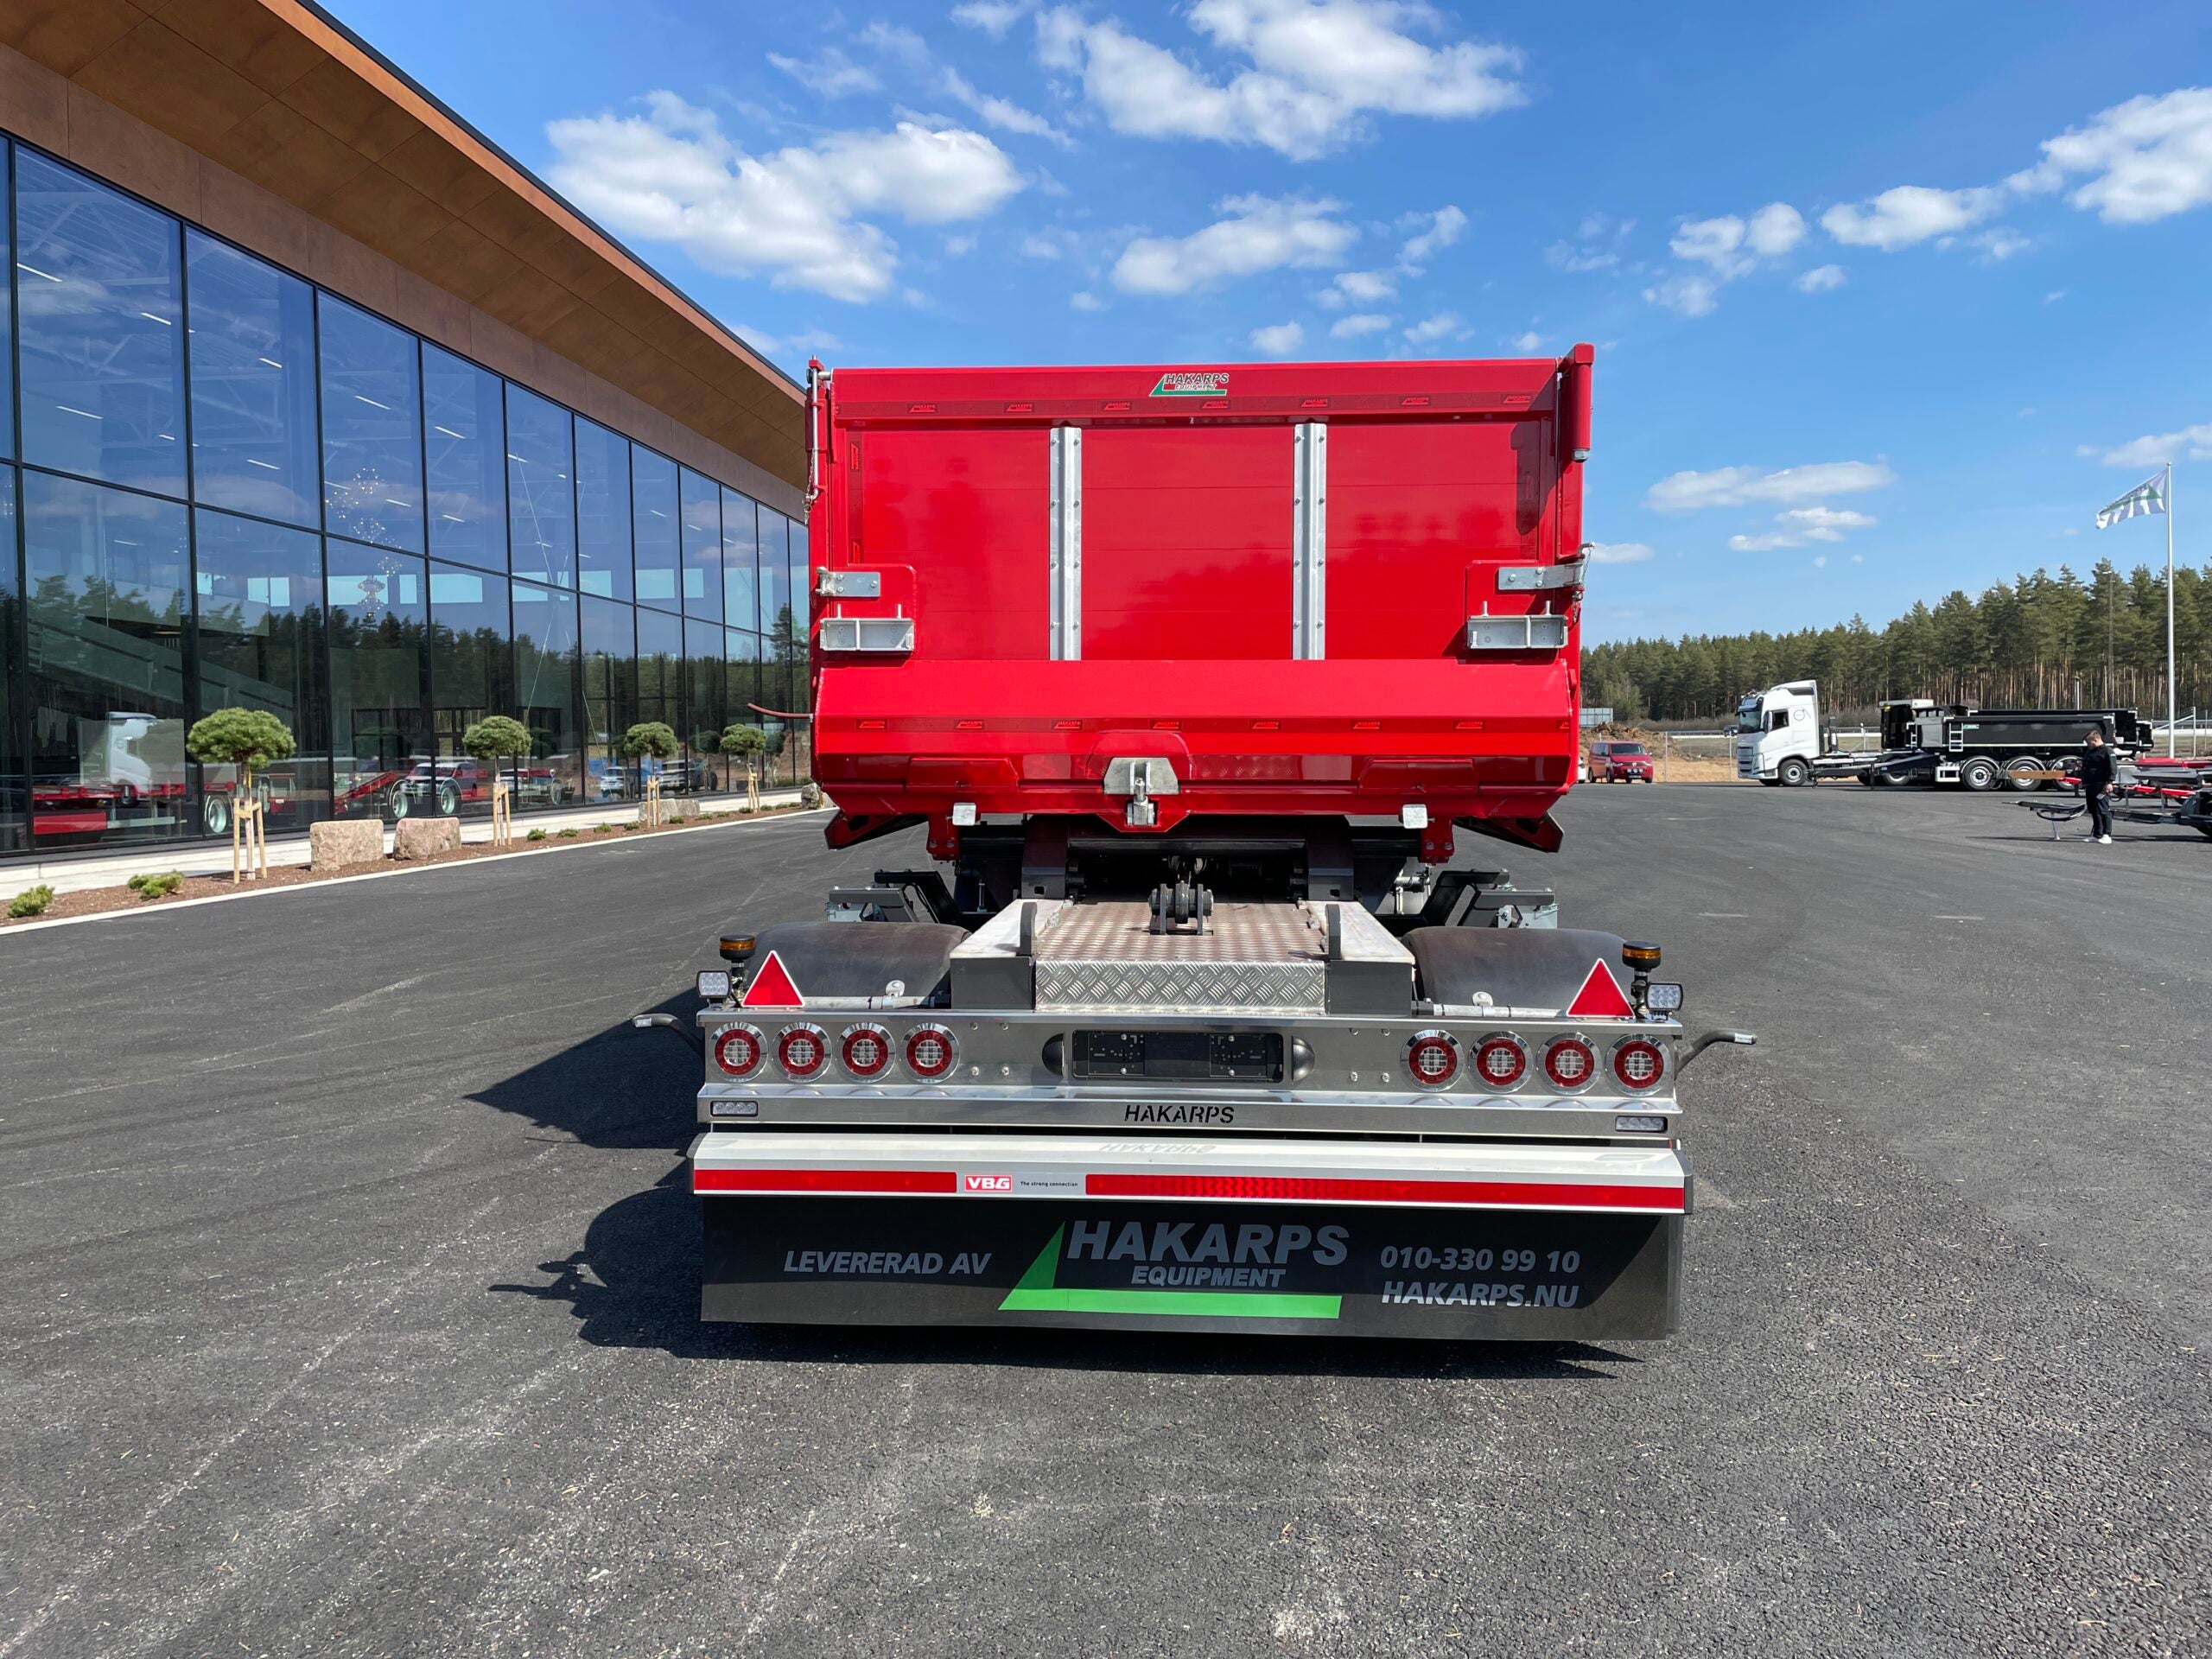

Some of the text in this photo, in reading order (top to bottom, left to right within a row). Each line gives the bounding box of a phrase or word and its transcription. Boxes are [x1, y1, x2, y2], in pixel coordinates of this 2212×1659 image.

[1166, 373, 1229, 384] HAKARPS
[1124, 1104, 1235, 1123] HAKARPS
[967, 1177, 1010, 1190] VBG
[1066, 1220, 1350, 1266] HAKARPS
[784, 1251, 993, 1274] LEVERERAD AV
[1380, 1246, 1581, 1273] 010-330 99 10
[1131, 1266, 1286, 1287] EQUIPMENT
[1382, 1281, 1580, 1307] HAKARPS.NU
